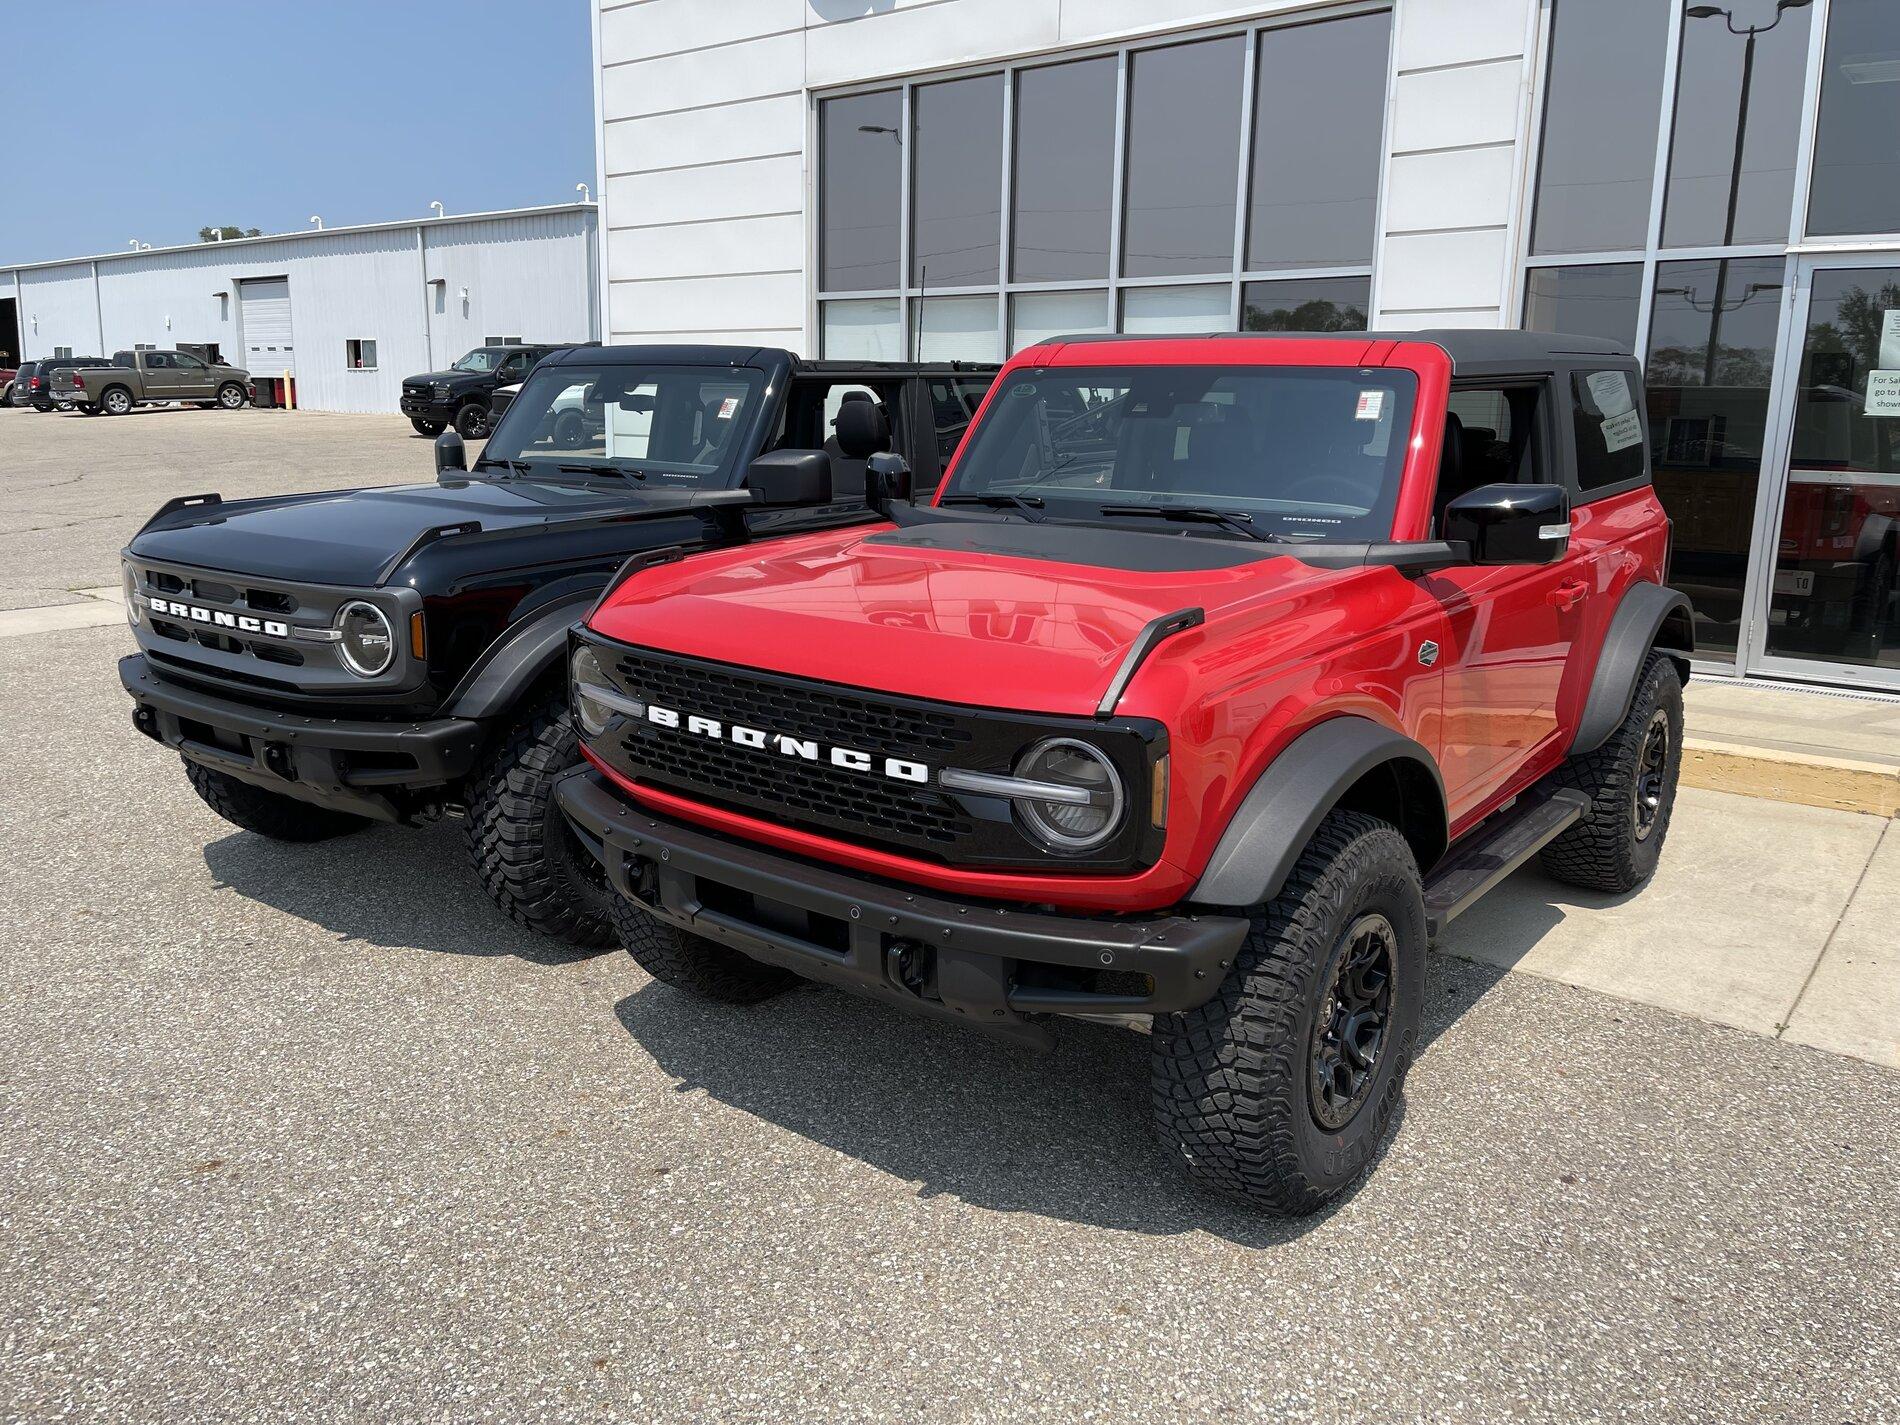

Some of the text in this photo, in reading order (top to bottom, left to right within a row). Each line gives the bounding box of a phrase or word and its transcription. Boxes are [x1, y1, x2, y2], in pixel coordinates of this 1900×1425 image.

[1873, 376, 1887, 384] For
[1875, 389, 1886, 398] go
[150, 597, 288, 636] BRONCO
[648, 705, 928, 783] BRONCO
